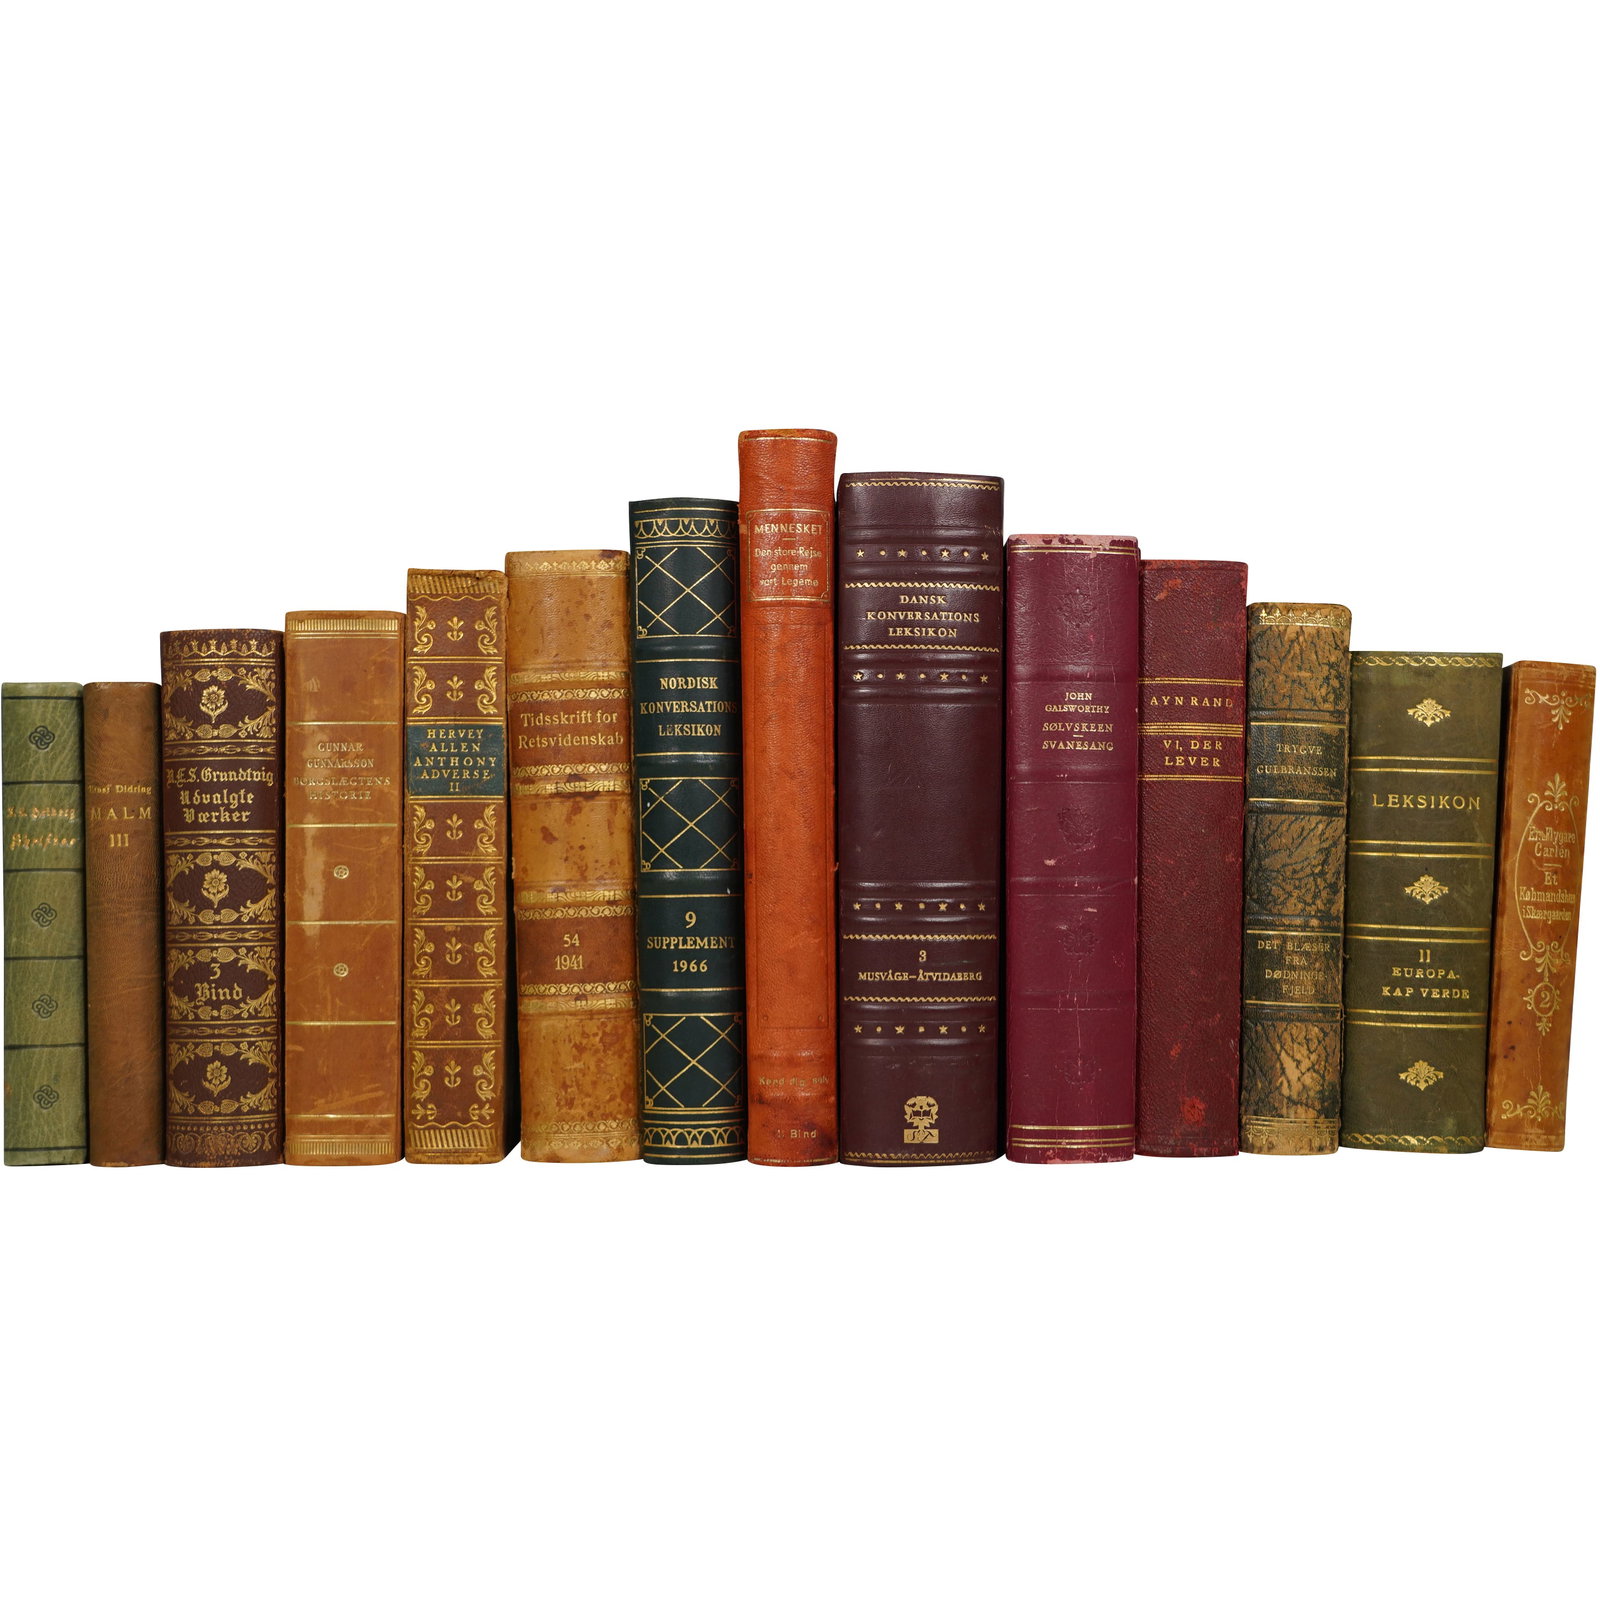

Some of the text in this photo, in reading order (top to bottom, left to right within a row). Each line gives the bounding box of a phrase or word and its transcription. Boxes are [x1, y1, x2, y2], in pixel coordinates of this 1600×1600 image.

[754, 523, 822, 535] MENNESKET
[755, 546, 822, 558] Den store Rejse
[770, 563, 808, 573] gennem
[781, 577, 819, 587] Legeme
[900, 595, 947, 604] DANSK
[866, 611, 980, 623] KONVERSATIONS
[888, 627, 957, 638] LEKSIKON
[660, 676, 718, 690] NORDISK
[1064, 692, 1093, 701] JOHN
[1150, 696, 1233, 708] AYN RAND
[640, 700, 737, 715] KONVERSATIONS
[1045, 704, 1110, 714] GALSWORTHY
[520, 711, 619, 728] Tidsskrift for
[427, 728, 484, 739] HERVEY
[659, 723, 721, 737] LEKSIKON
[1042, 722, 1113, 733] SØLVSKEEN
[317, 742, 364, 752] GUNNAR
[518, 733, 624, 749] Retsvidenskab
[1042, 740, 1114, 751] SVANESANG
[1190, 740, 1223, 750] DER
[429, 743, 481, 753] ALLEN
[1276, 744, 1323, 755] TRYGVE
[413, 757, 497, 768] ANTHONY
[1165, 756, 1221, 767] LEVER
[420, 769, 490, 780] ADVERSE
[1256, 764, 1338, 778] GULBRANSSEN
[1372, 794, 1481, 810] LEKSIKON
[1543, 871, 1559, 886] Et
[684, 911, 697, 928] 9
[562, 934, 581, 948] 54
[646, 936, 736, 949] SUPPLEMENT
[1257, 940, 1279, 950] DET
[918, 950, 928, 962] 3
[1285, 956, 1308, 966] FRA
[554, 954, 584, 971] 1941
[672, 959, 709, 973] 1966
[210, 962, 221, 980] 3
[194, 981, 243, 1006] Bind
[1281, 984, 1316, 996] FJELD
[1381, 986, 1470, 999] KAP VERDE
[1540, 991, 1551, 1008] 2
[790, 1129, 817, 1139] Bind
